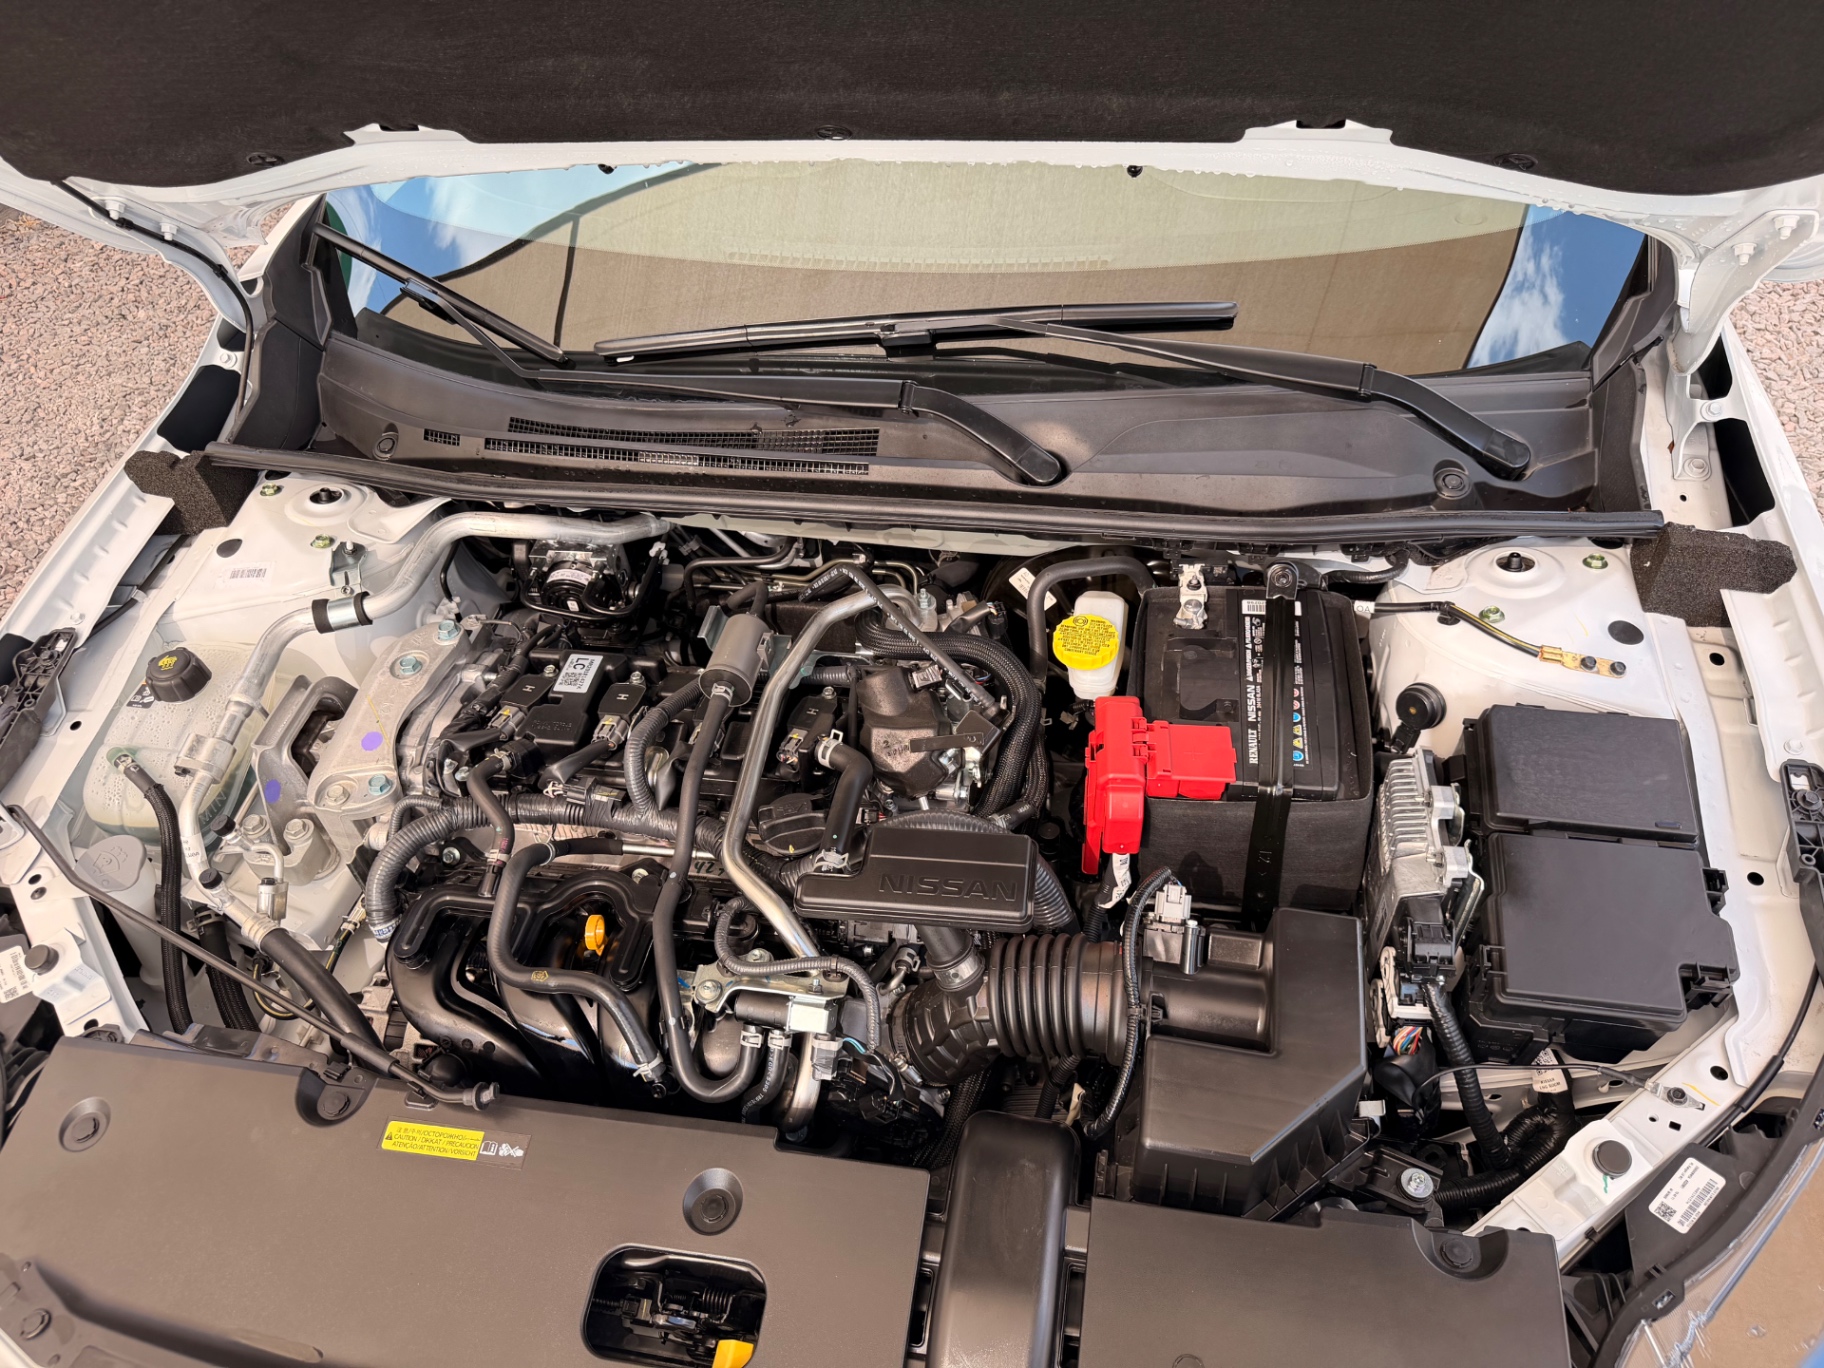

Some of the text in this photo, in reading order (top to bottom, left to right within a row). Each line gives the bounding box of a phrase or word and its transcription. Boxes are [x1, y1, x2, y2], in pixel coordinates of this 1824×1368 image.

[573, 657, 590, 670] LC
[522, 684, 536, 693] H
[616, 692, 629, 701] H
[806, 707, 819, 716] H
[1247, 685, 1258, 764] RENAULT NISSAN
[198, 790, 227, 825] MIN
[879, 873, 1017, 901] NISSAN
[394, 1133, 418, 1142] CAUTION
